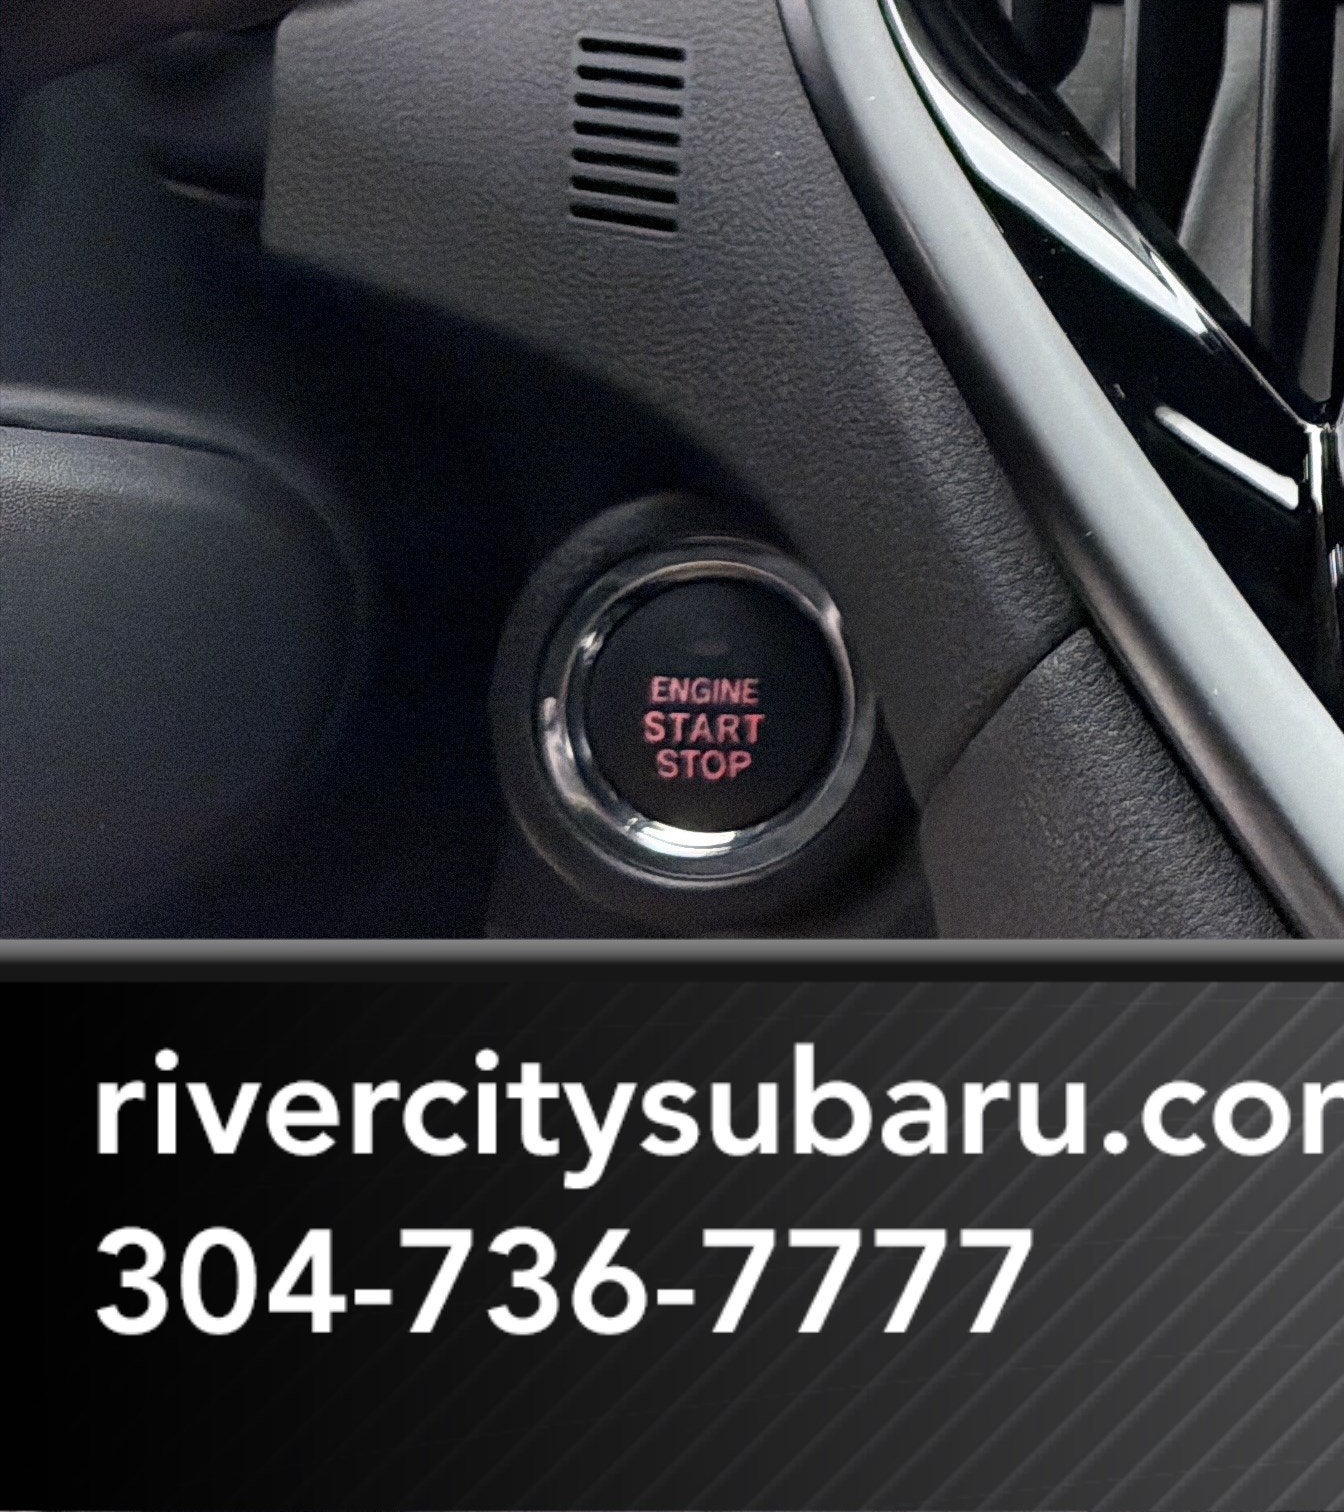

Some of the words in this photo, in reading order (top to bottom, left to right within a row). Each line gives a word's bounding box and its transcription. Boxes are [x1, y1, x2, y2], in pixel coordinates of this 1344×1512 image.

[651, 676, 760, 706] ENGINE
[644, 711, 766, 744] START
[656, 748, 753, 781] STOP
